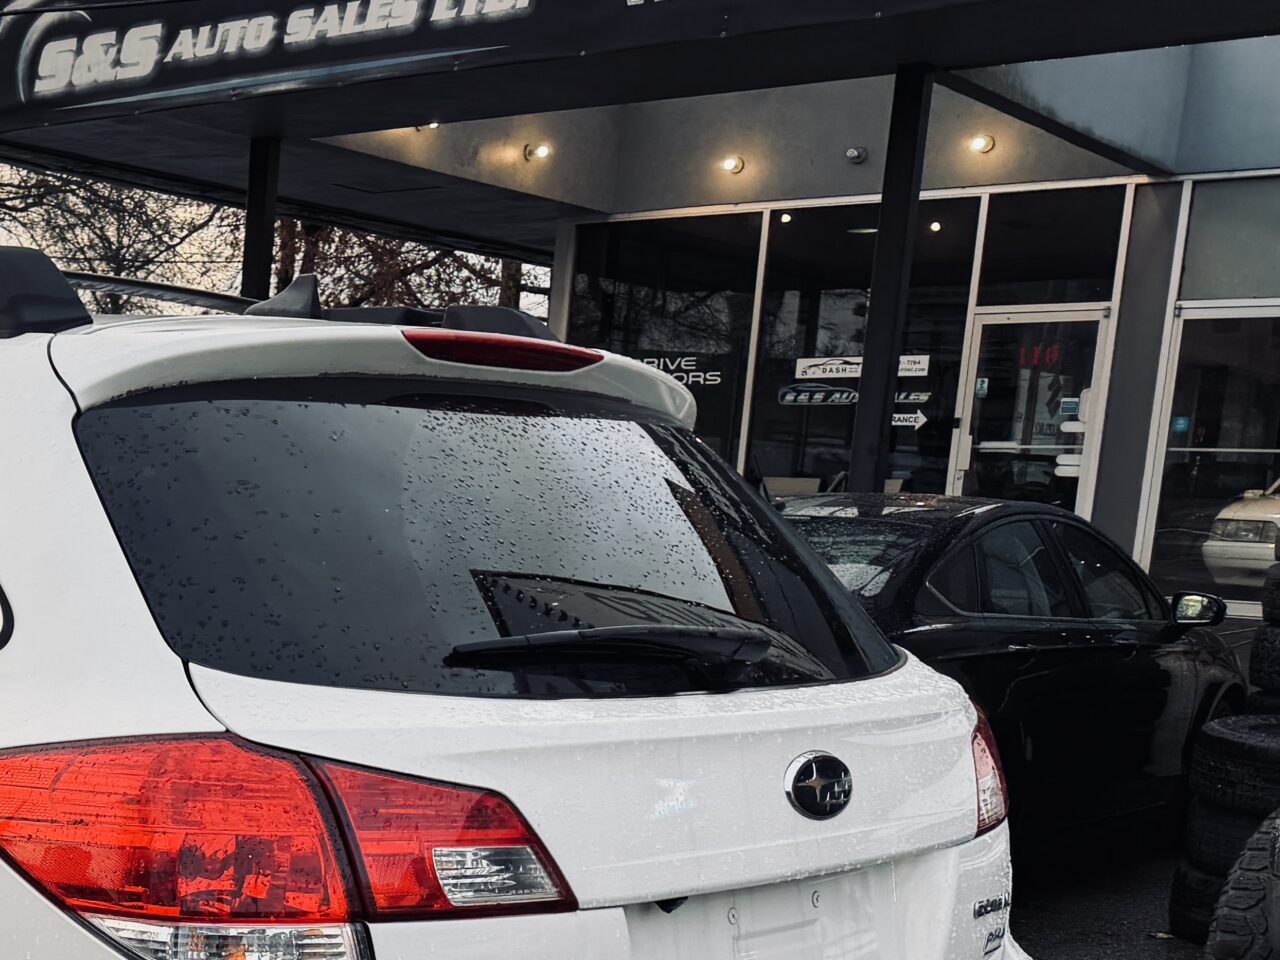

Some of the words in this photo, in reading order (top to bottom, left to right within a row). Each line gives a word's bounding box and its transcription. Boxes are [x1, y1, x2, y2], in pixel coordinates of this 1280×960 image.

[34, 23, 162, 92] S&S
[164, 15, 277, 62] AUTO
[284, 0, 418, 43] SALES
[642, 357, 697, 370] RIVE
[822, 366, 847, 374] DASH
[670, 372, 721, 384] ORS
